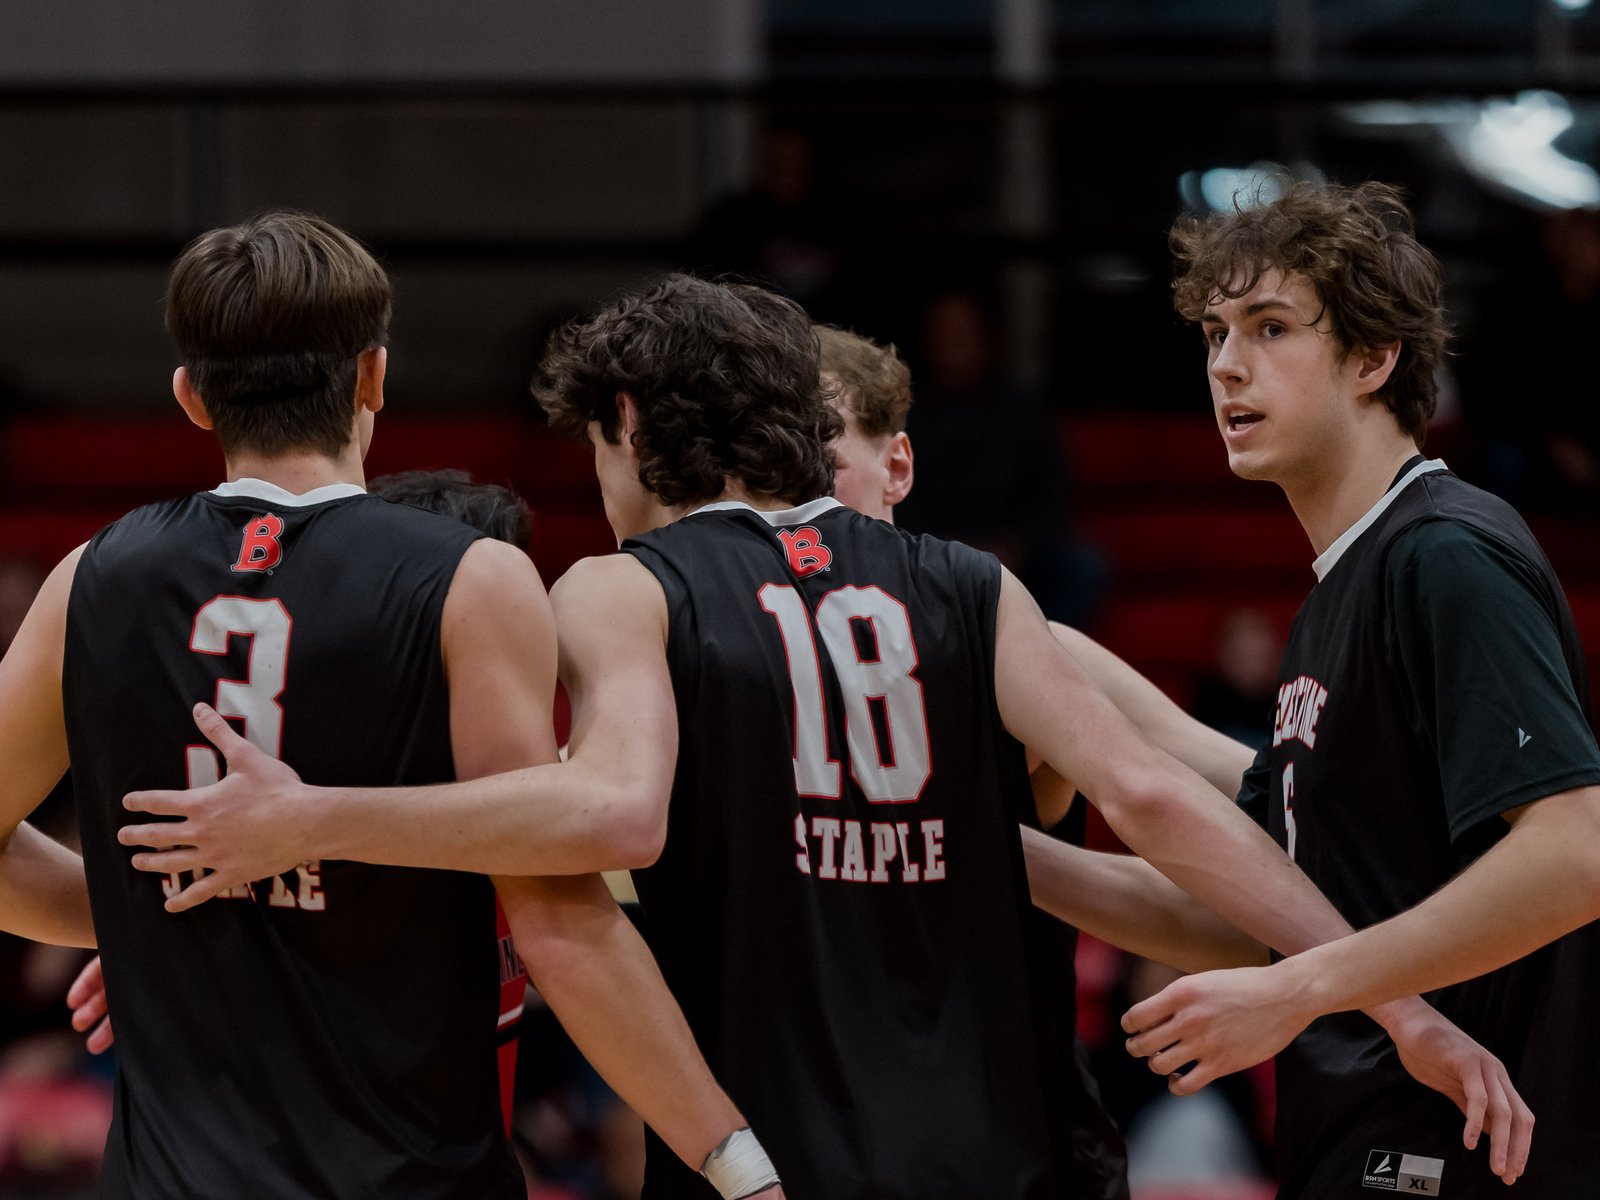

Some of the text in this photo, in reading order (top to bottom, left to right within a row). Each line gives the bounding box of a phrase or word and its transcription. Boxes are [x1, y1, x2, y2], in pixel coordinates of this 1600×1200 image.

[231, 513, 285, 573] B
[776, 526, 832, 581] B
[186, 594, 294, 792] 3
[757, 582, 933, 804] 18
[794, 811, 947, 884] STAPLE
[1408, 1177, 1429, 1191] XL
